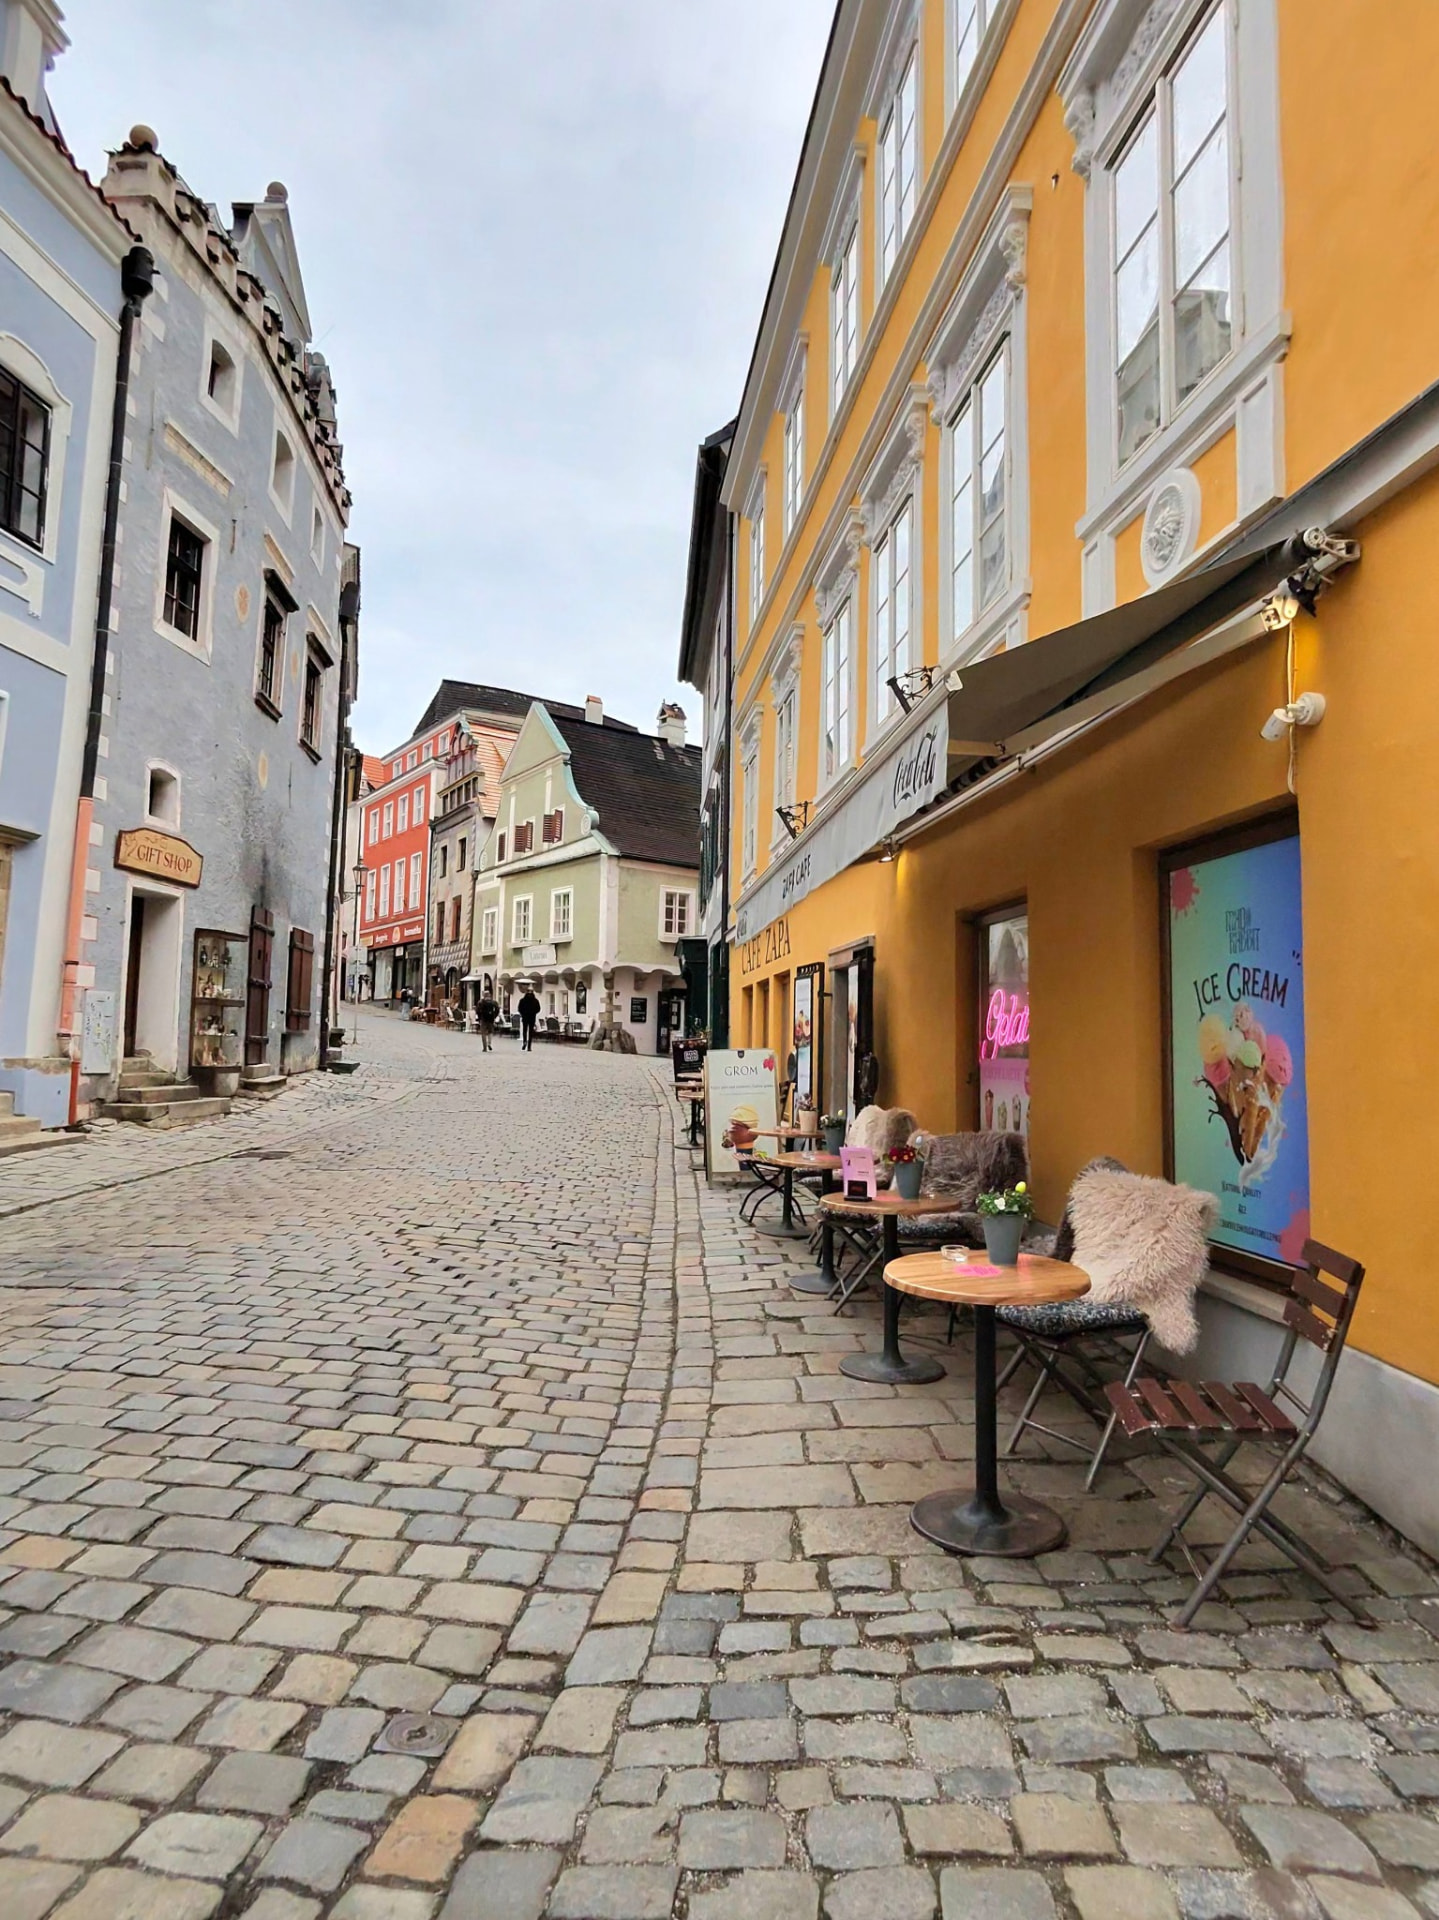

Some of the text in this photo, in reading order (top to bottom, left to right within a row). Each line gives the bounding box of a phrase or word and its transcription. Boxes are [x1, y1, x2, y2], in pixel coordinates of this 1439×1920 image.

[137, 844, 193, 873] GIFT SHOP
[742, 934, 761, 975] CAFE
[765, 916, 791, 964] ZAPA
[1193, 962, 1289, 1022] ICE CREAM
[724, 1065, 759, 1077] GROM
